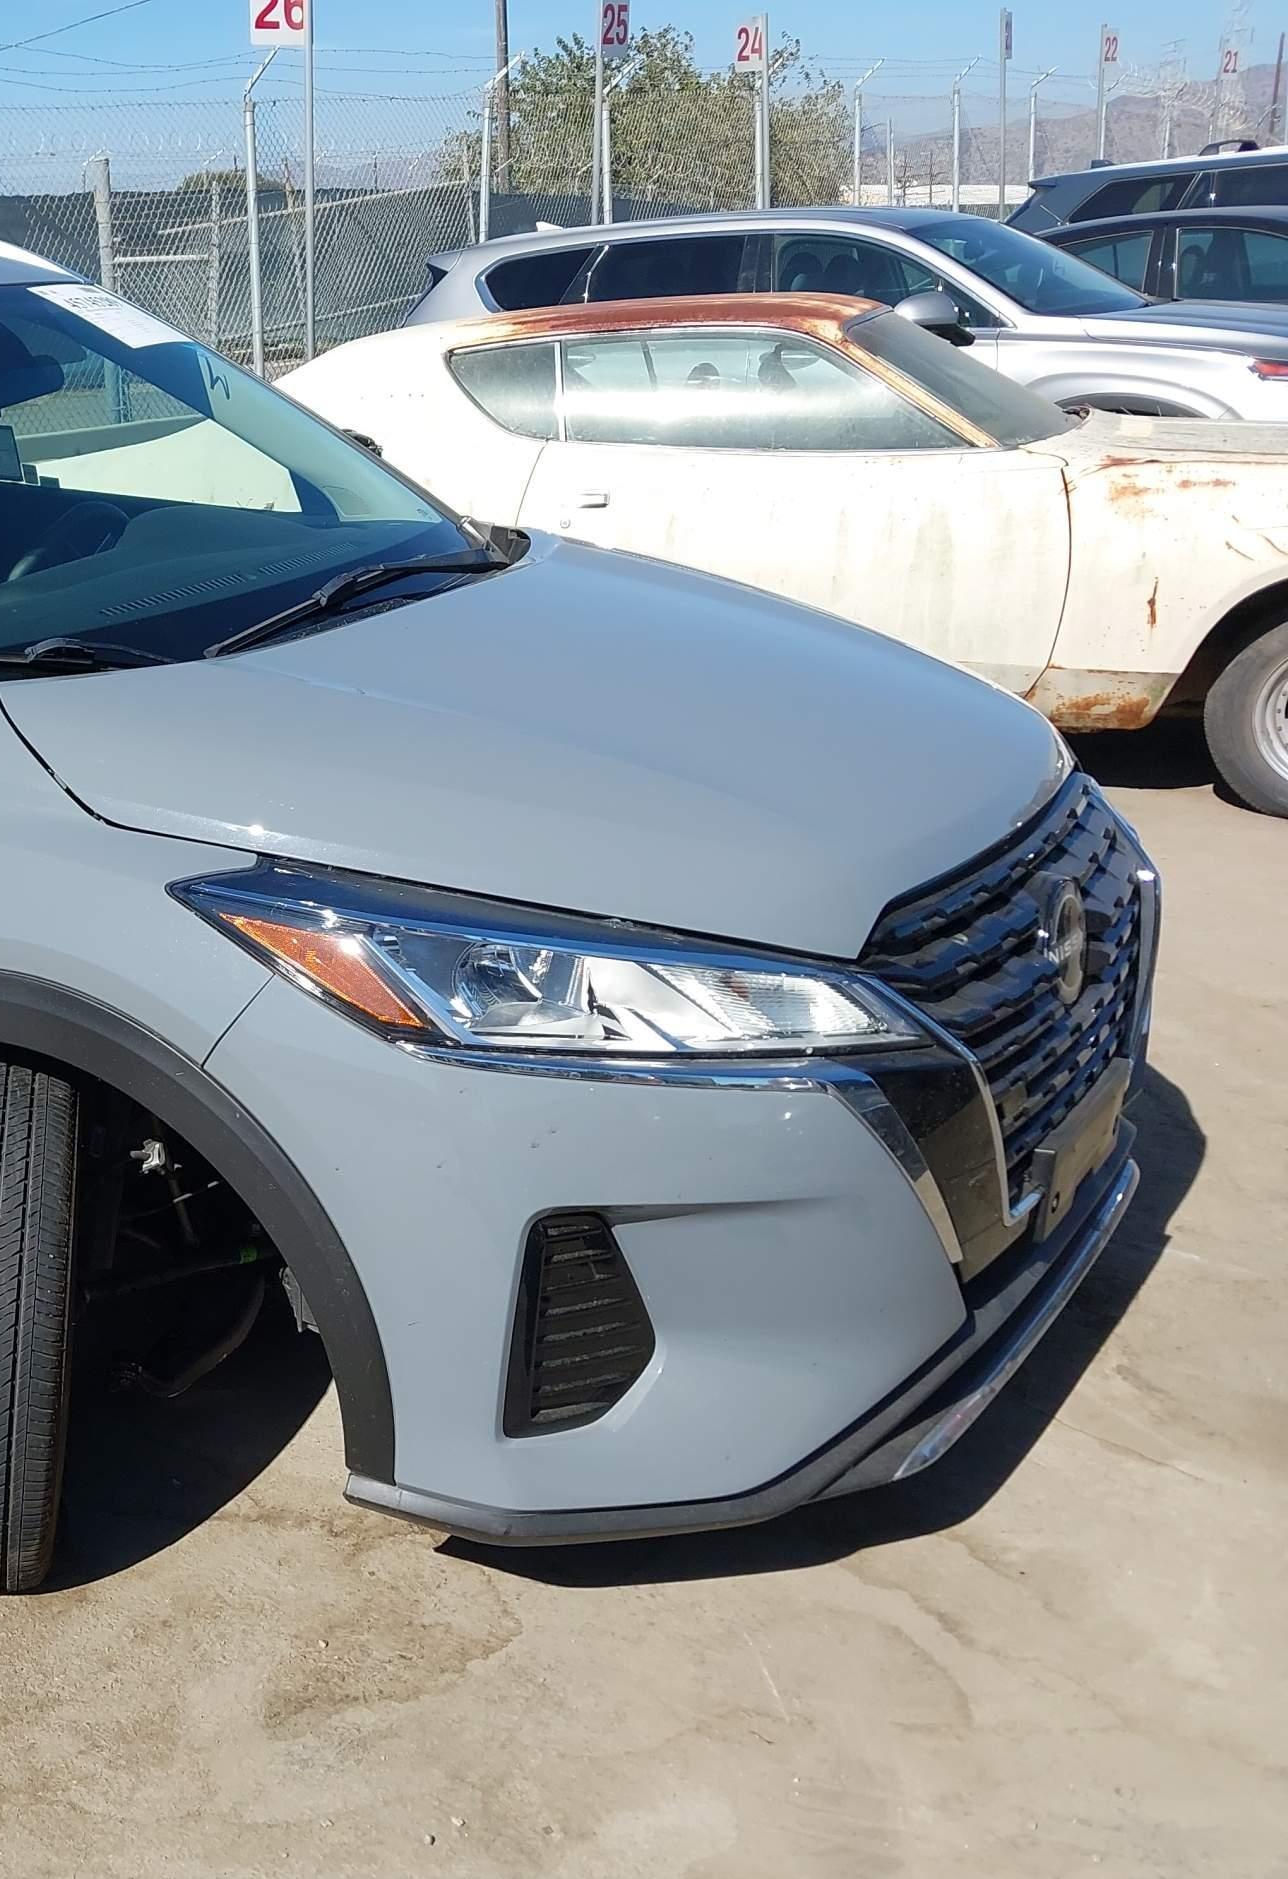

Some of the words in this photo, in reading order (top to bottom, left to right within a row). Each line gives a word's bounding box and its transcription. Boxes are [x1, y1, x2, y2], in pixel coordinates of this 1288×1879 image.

[254, 0, 304, 30] 26
[602, 3, 628, 46] 25
[737, 26, 763, 62] 24
[1103, 36, 1118, 62] 22
[1223, 50, 1239, 73] 21
